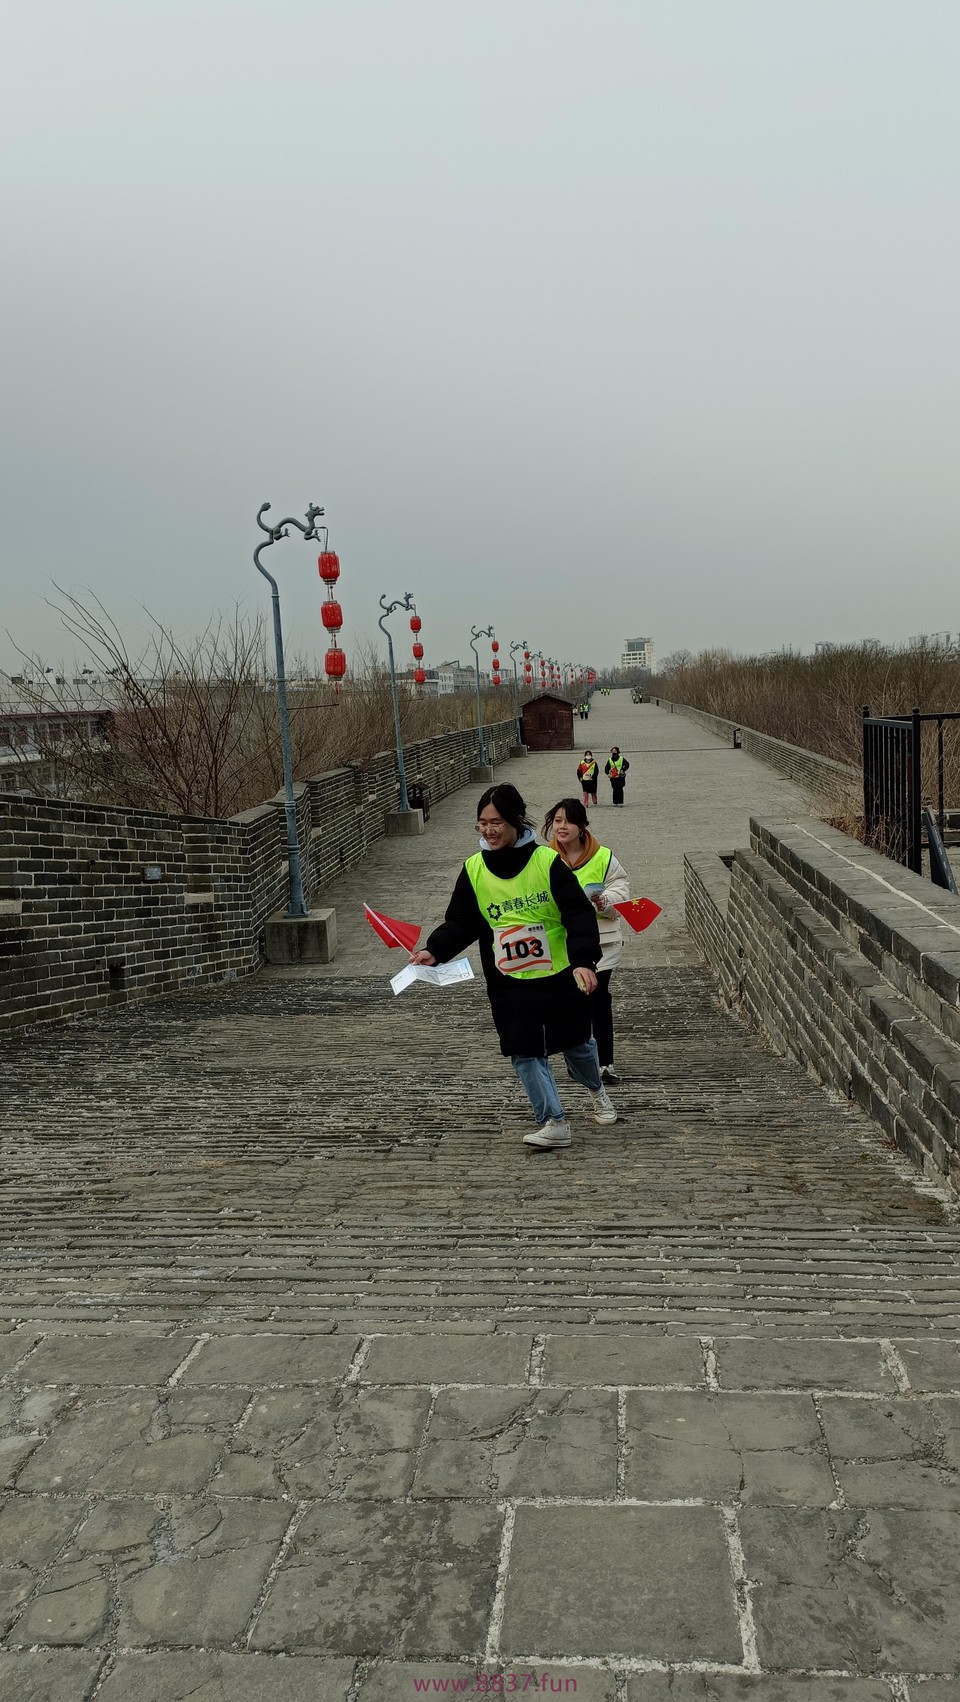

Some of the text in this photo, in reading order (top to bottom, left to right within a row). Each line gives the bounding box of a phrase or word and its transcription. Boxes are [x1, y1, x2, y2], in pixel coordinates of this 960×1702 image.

[501, 891, 550, 912] 青春长城
[502, 939, 544, 961] 103
